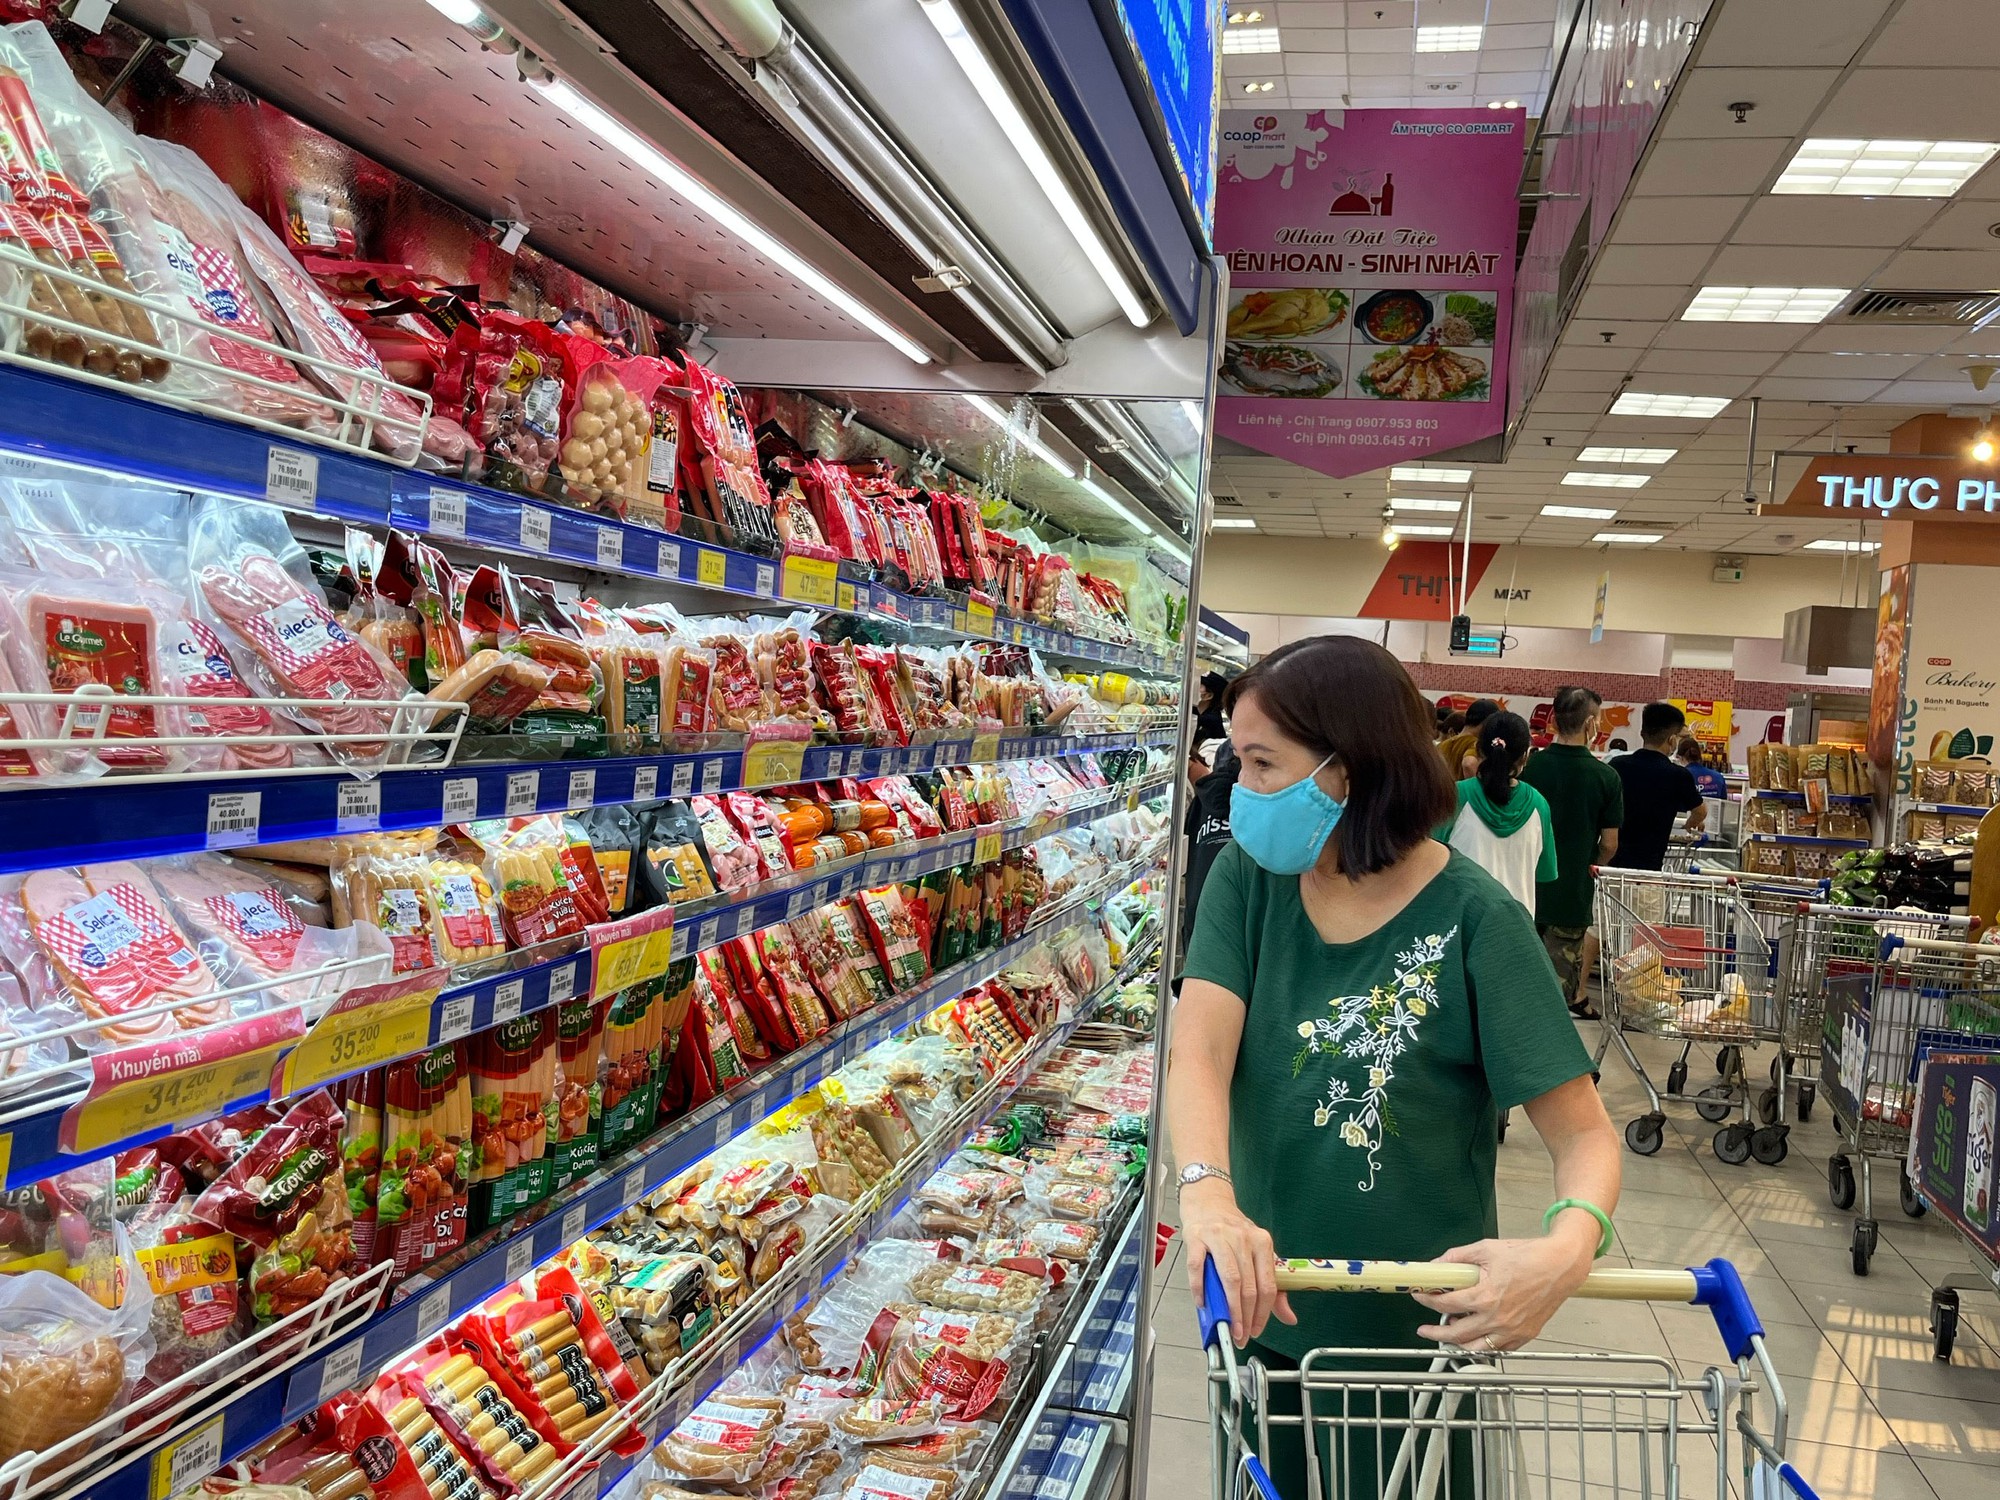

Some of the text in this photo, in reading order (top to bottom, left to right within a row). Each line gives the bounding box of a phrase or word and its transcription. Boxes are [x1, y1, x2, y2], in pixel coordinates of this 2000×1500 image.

[1412, 124, 1443, 137] THỰC
[1447, 123, 1513, 134] CO.OPMART
[1275, 229, 1438, 246] Nhận Đặt Tiệc
[1269, 253, 1343, 272] HOAN
[1361, 253, 1420, 273] SINH
[1425, 250, 1500, 277] NHẬT
[1238, 414, 1263, 426] Liên
[1266, 415, 1283, 428] hệ
[1294, 415, 1315, 428] Chị
[1318, 416, 1352, 431] Trang
[1355, 417, 1412, 429] 0907.953
[1416, 418, 1438, 430] 803
[1293, 431, 1314, 446] Chị
[1317, 431, 1346, 446] Định
[1349, 433, 1405, 446] 0903.645
[1409, 434, 1431, 447] 471
[1816, 476, 1939, 516] THỰC
[1398, 574, 1531, 604] THỊT MEAT
[59, 633, 70, 643] Le
[1928, 658, 1951, 666] COOP
[1925, 670, 1997, 696] Bakery
[219, 810, 239, 818] 40.800
[111, 1047, 201, 1080] Khuyến mãi
[1967, 1132, 1991, 1174] Tiger
[180, 1249, 200, 1277] BIỆT
